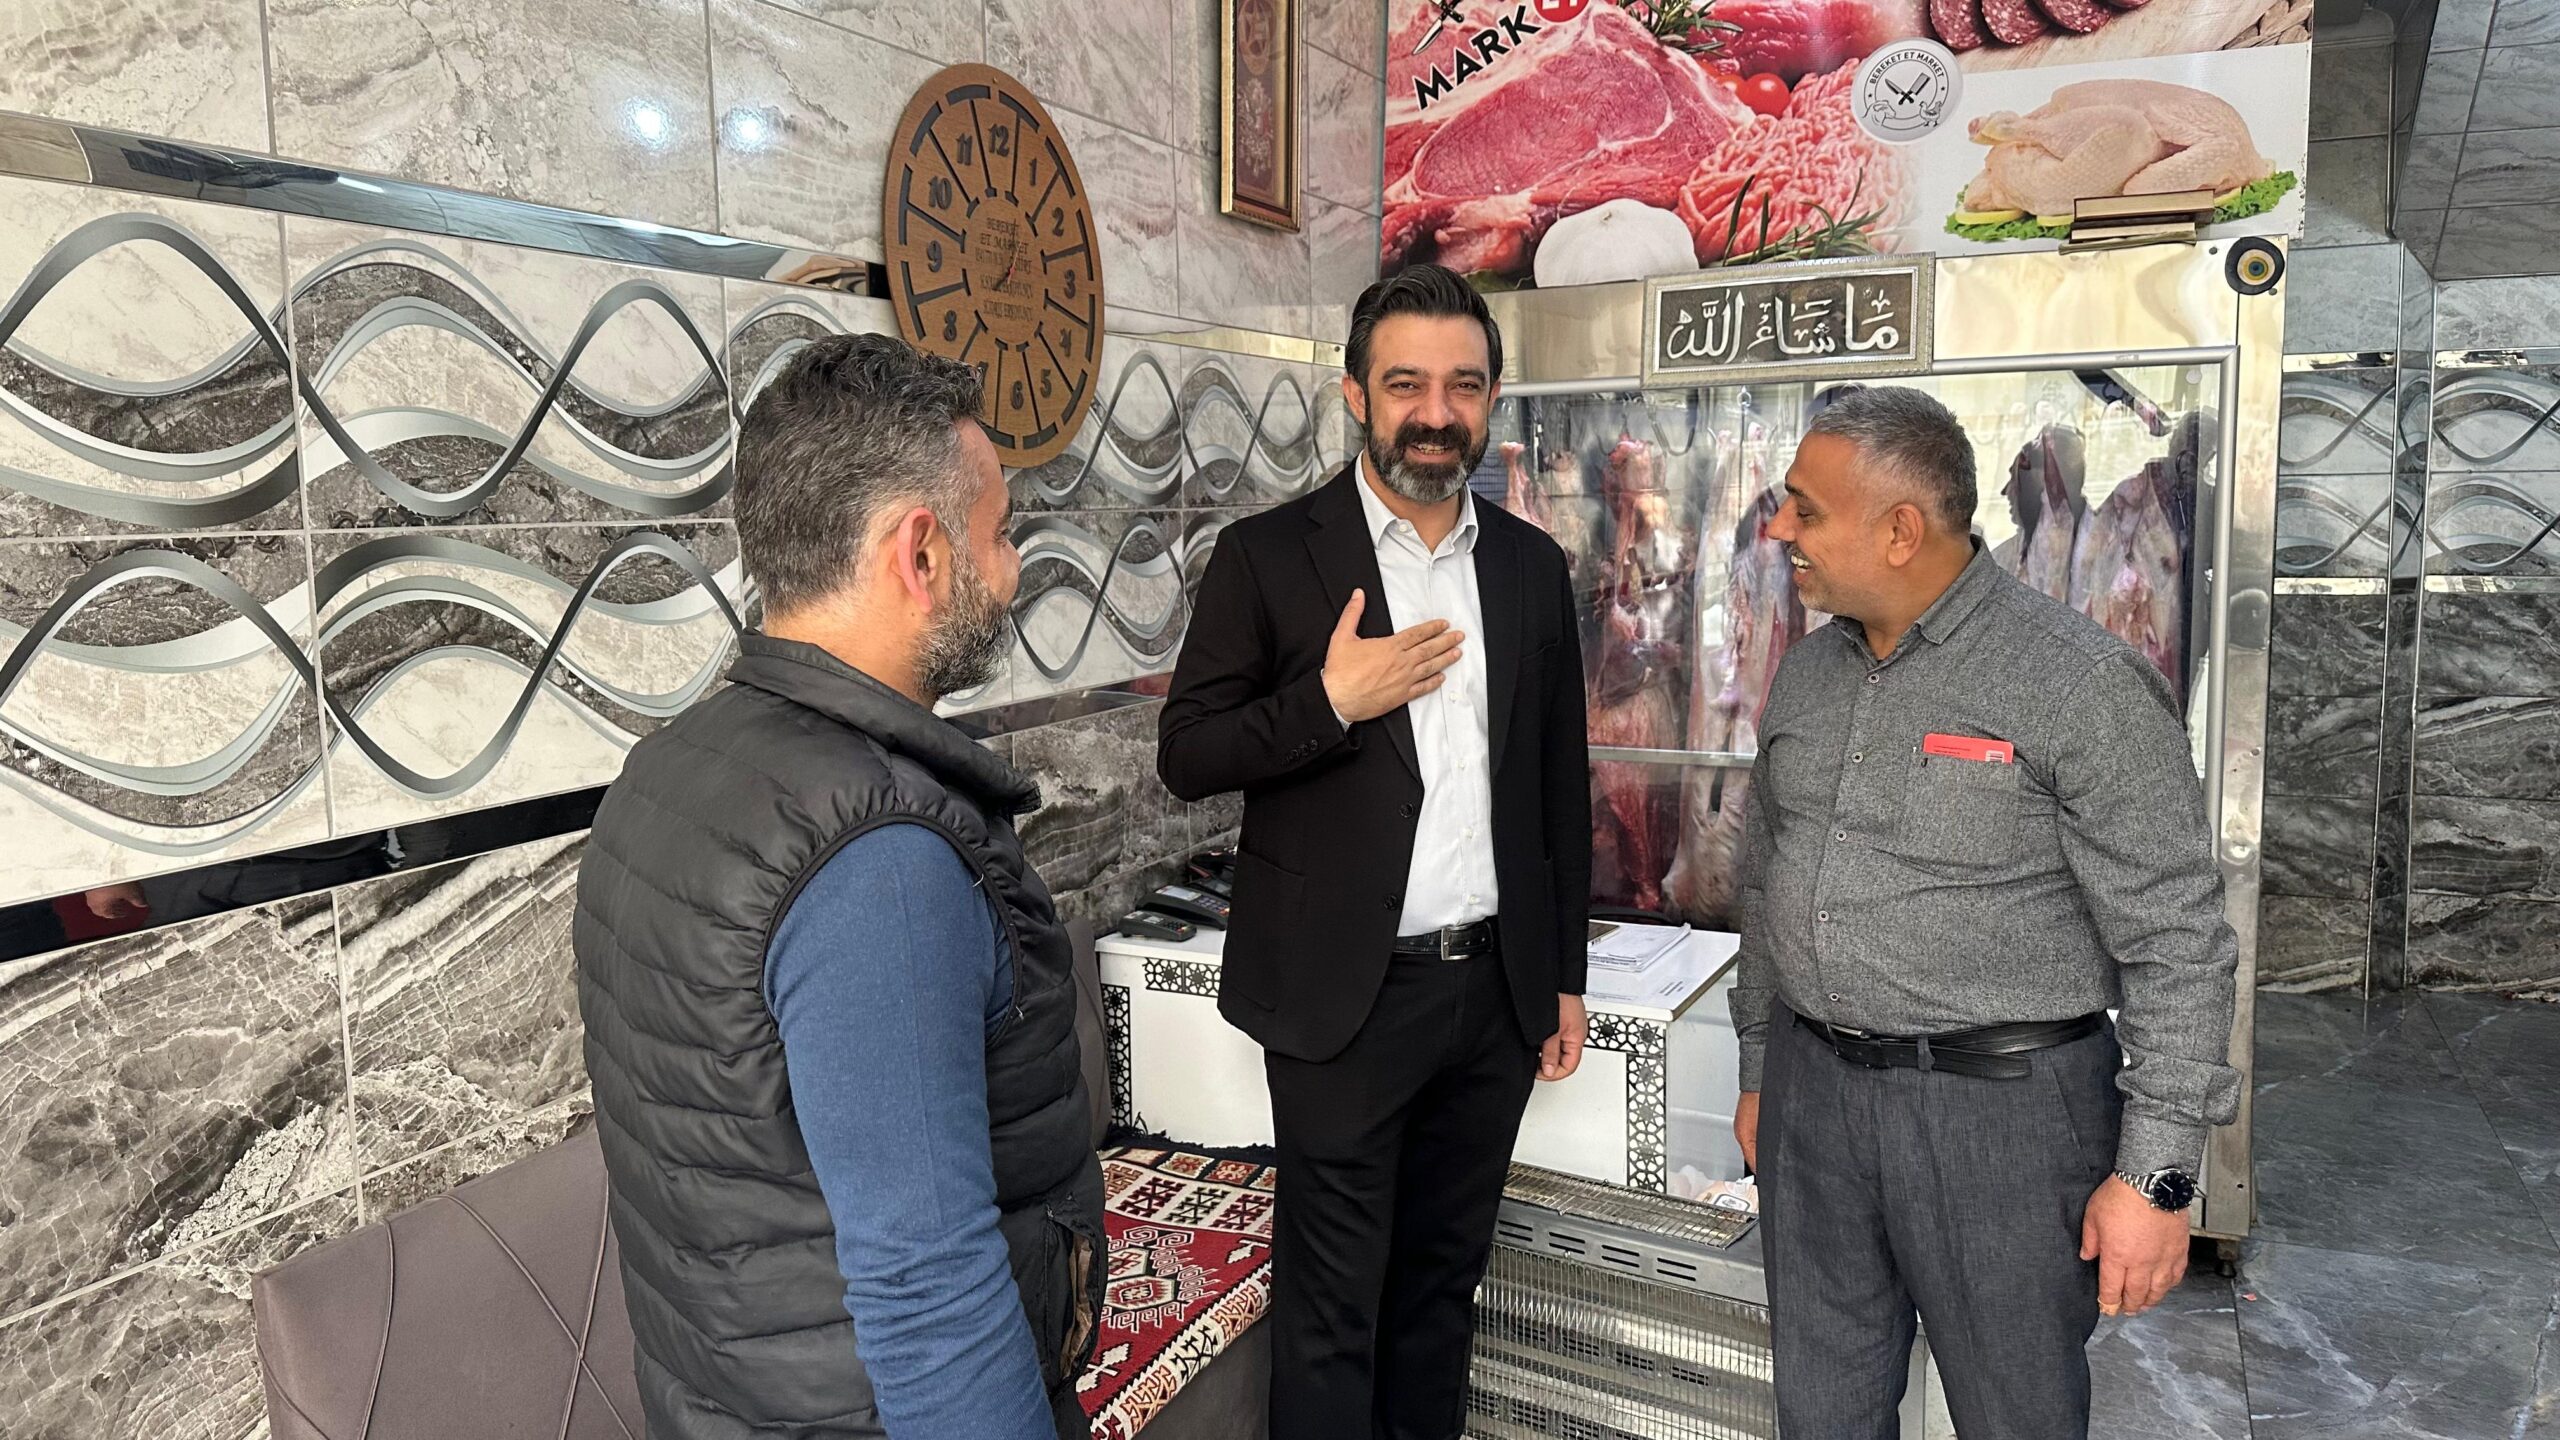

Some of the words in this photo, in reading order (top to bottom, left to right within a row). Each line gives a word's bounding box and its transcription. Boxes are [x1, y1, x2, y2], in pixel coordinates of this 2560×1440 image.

[1869, 53, 1901, 85] BEREKET
[1904, 51, 1915, 60] ET
[1916, 52, 1945, 78] MARKET
[956, 132, 973, 166] 11
[988, 123, 1010, 157] 12
[1029, 157, 1038, 187] 1
[928, 175, 952, 210] 10
[1052, 207, 1065, 237] 2
[980, 232, 992, 247] ET
[926, 239, 943, 273] 9
[1064, 269, 1076, 299] 3
[943, 310, 957, 342] 8
[1059, 327, 1072, 358] 4
[1010, 380, 1024, 410] 6
[1040, 368, 1051, 398] 5
